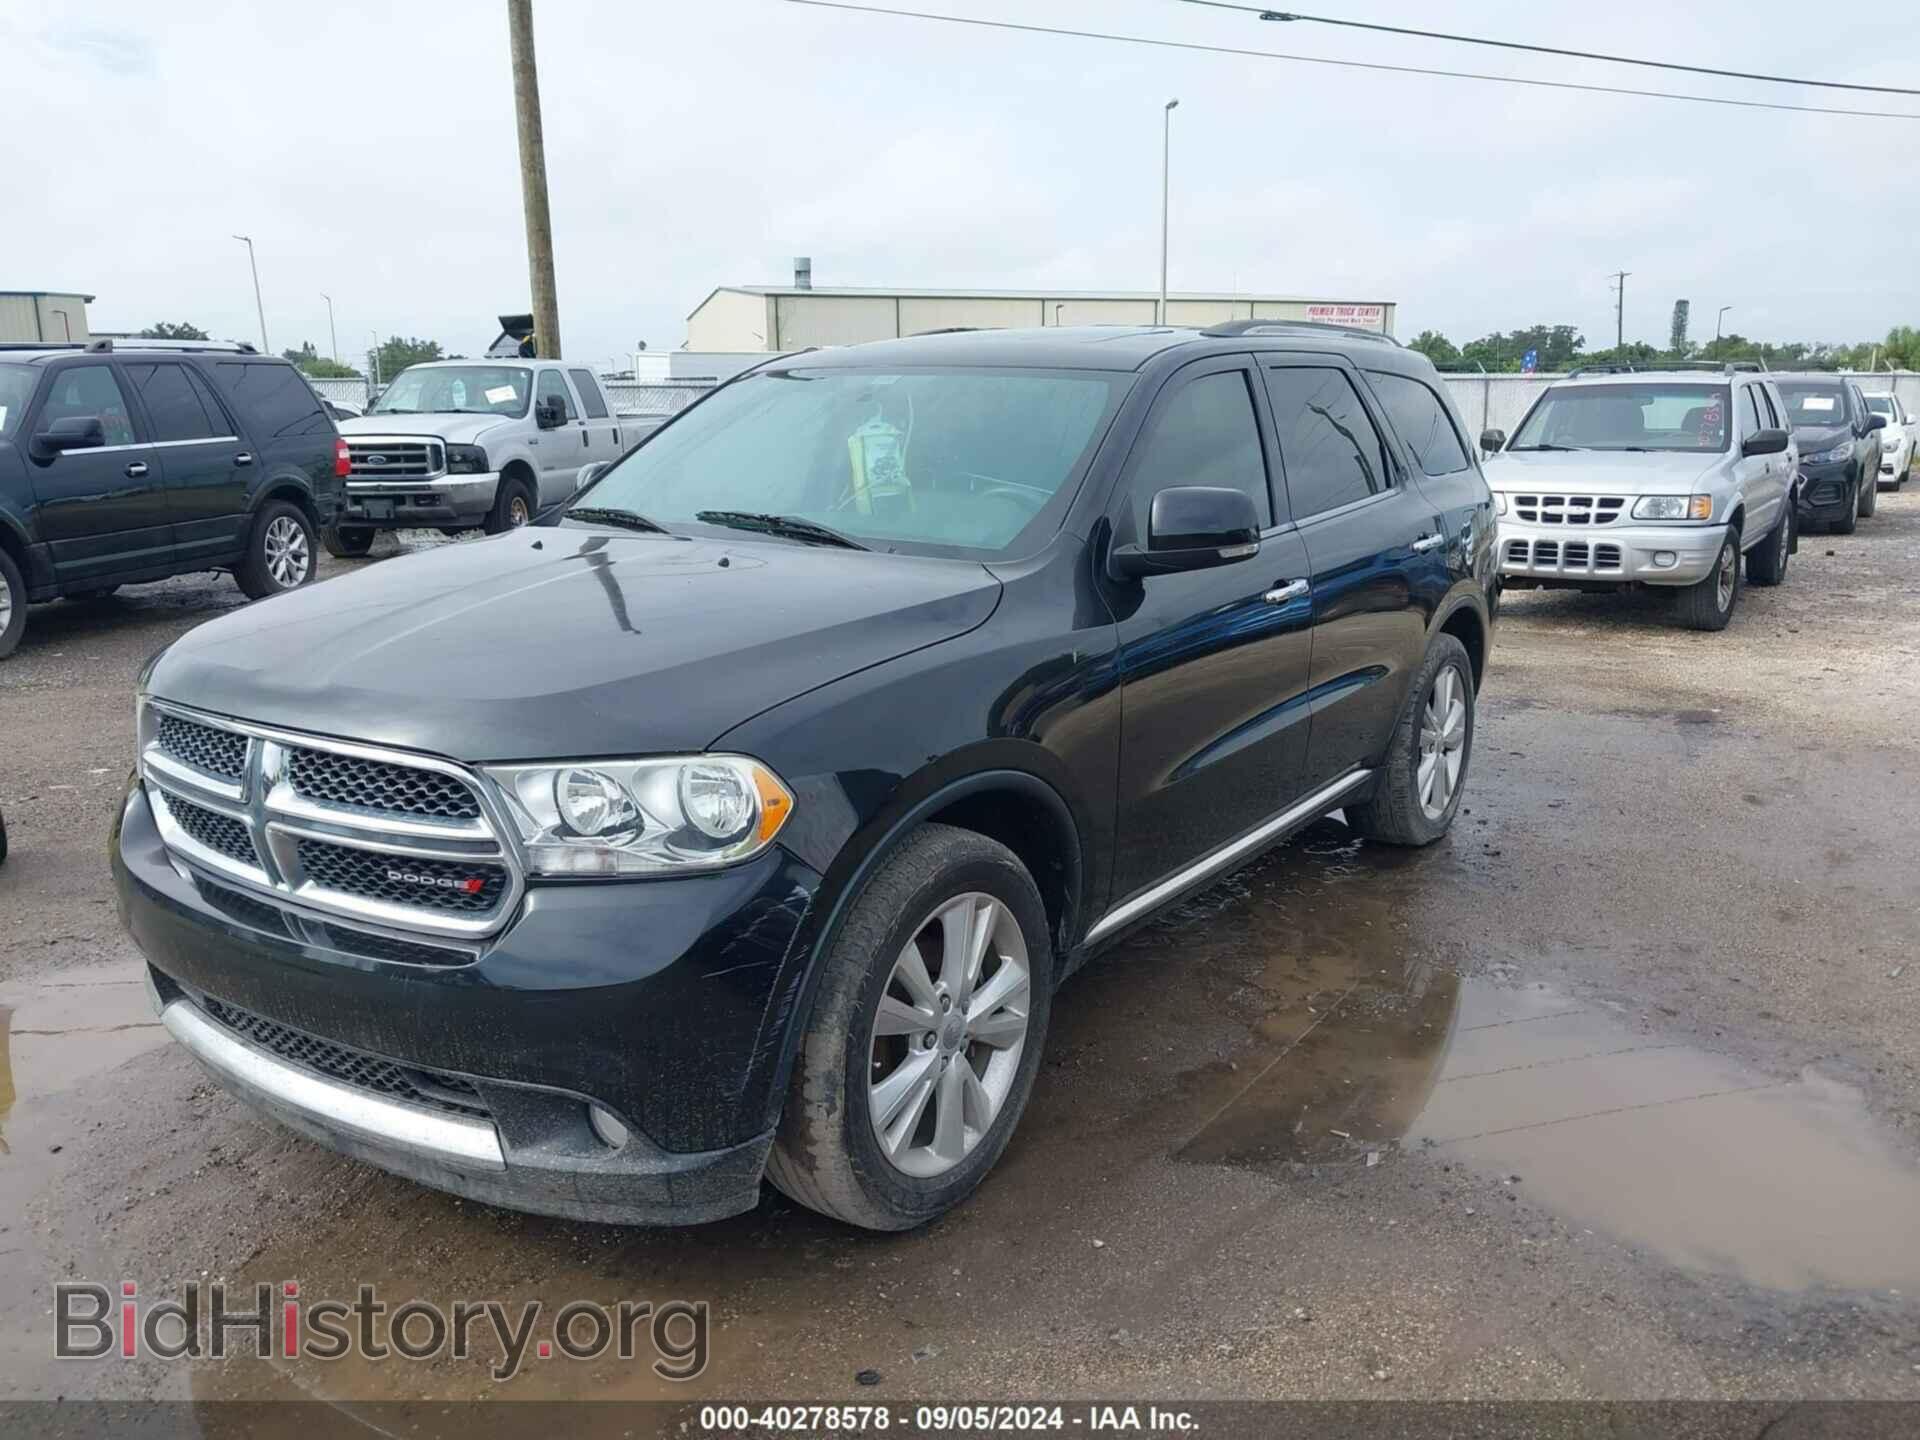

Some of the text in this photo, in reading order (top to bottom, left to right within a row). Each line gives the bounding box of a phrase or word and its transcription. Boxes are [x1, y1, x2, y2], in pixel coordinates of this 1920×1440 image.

[1308, 306, 1381, 317] PREMIER TRUCK CENTER
[387, 870, 466, 889] DODGE
